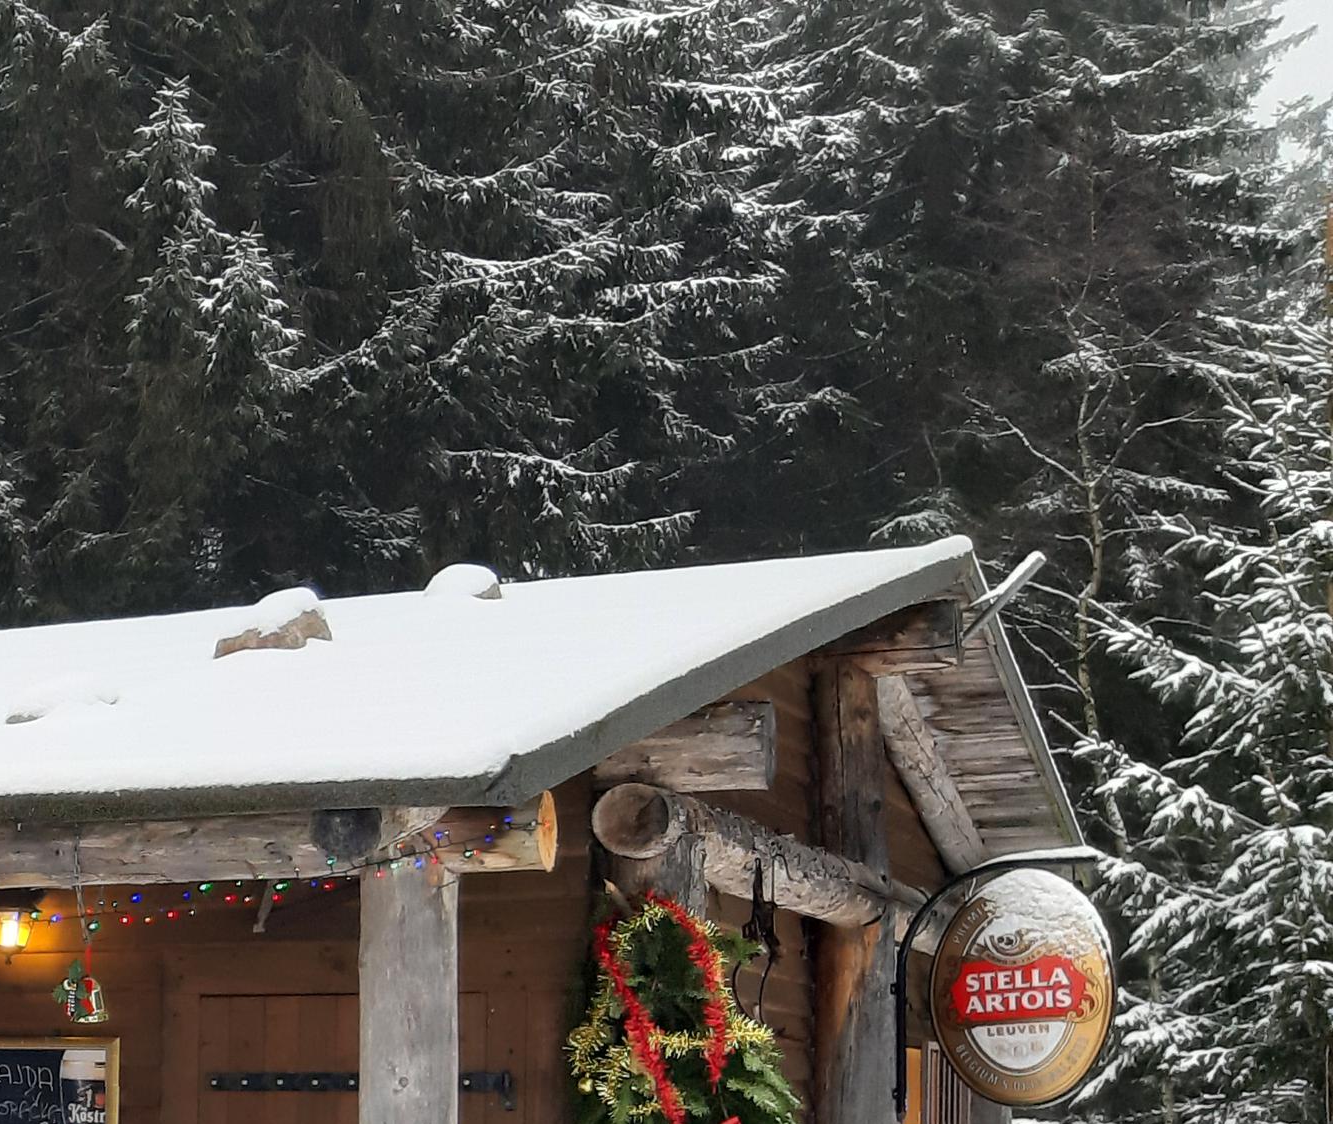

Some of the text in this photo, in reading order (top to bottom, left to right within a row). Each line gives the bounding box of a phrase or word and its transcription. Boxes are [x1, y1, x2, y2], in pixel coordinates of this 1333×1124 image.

[965, 967, 1071, 992] STELLA
[965, 988, 1072, 1014] ARTOIS
[986, 1023, 1050, 1037] LEUVEN
